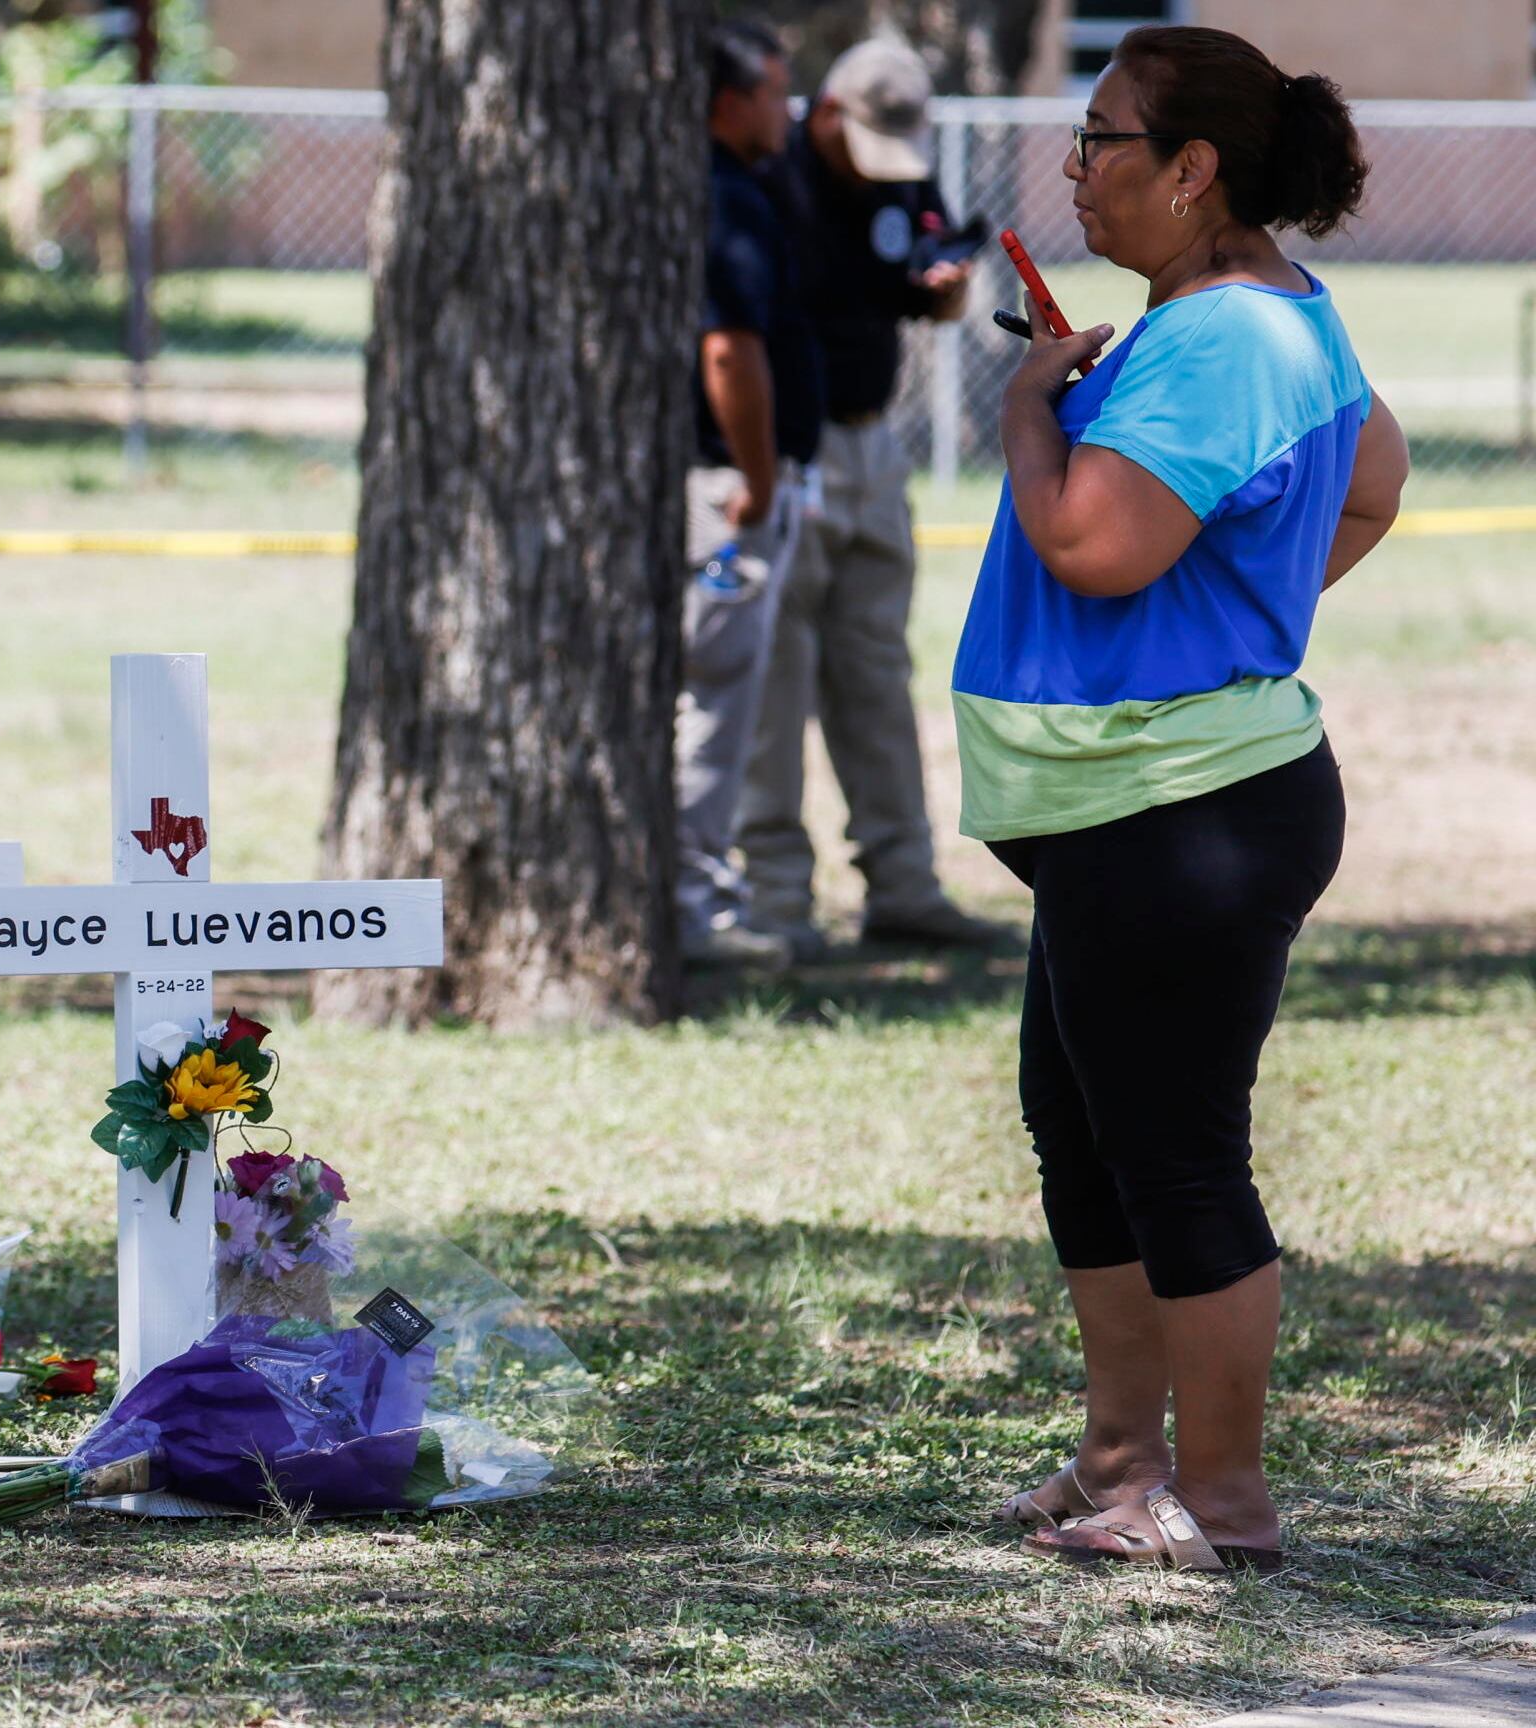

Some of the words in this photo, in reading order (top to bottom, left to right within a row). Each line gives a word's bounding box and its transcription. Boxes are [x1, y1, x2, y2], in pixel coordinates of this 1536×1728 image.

[146, 905, 387, 947] Luevanos
[137, 978, 206, 994] 5-24-22
[396, 1305, 412, 1320] DAY
